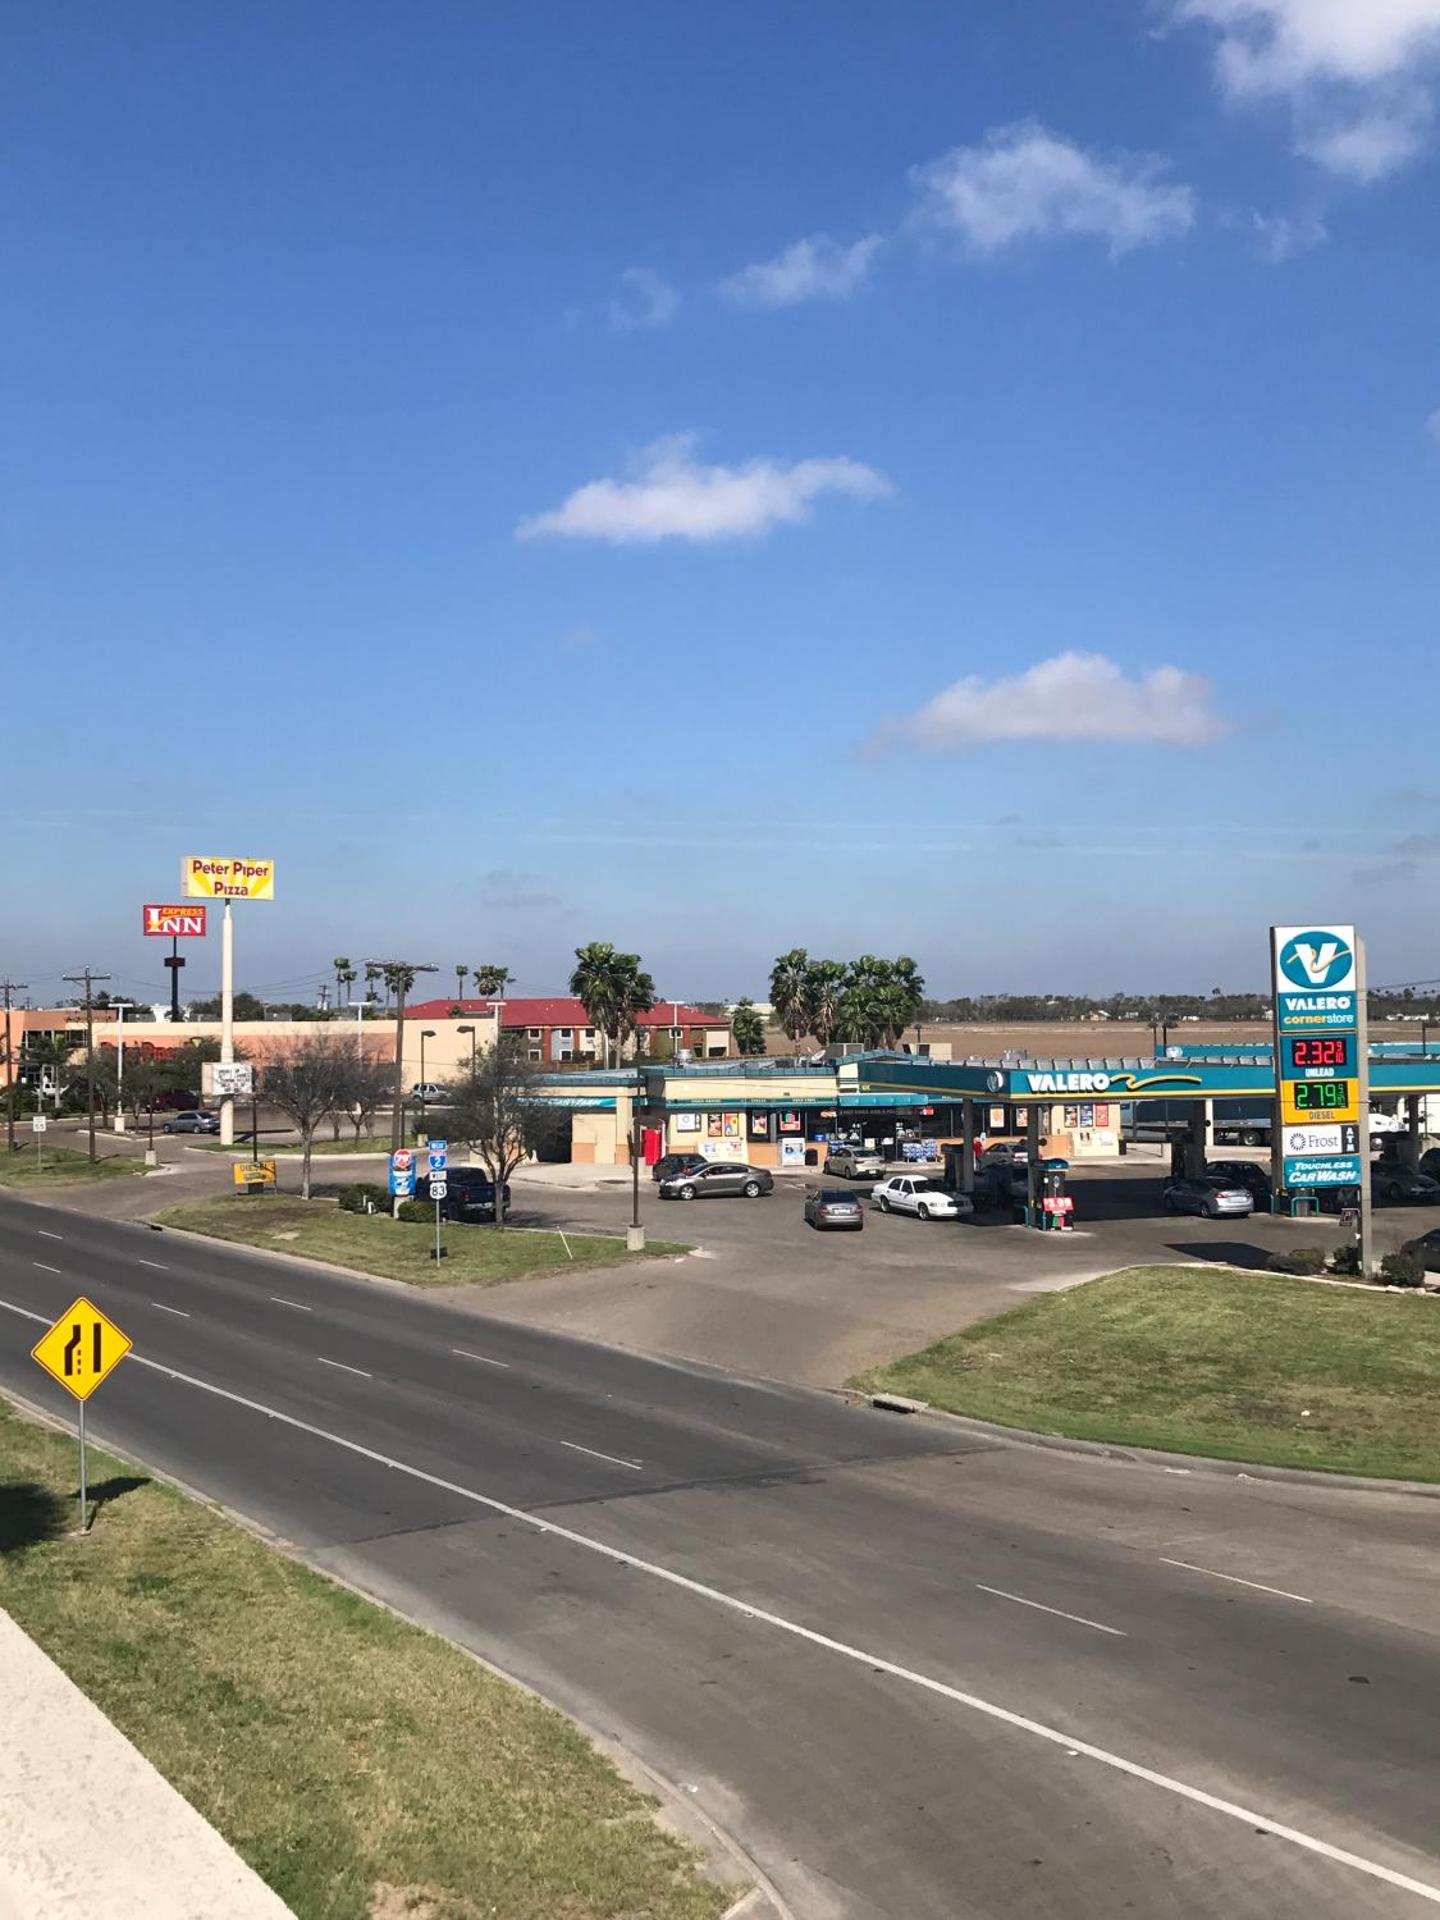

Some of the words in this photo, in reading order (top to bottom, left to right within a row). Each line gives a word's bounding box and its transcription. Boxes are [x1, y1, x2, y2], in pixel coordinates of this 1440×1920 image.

[193, 860, 229, 875] Peter
[233, 862, 269, 877] Piper
[214, 882, 248, 896] Pizza
[162, 907, 204, 916] EXPRESS
[147, 908, 203, 933] INN
[1285, 997, 1351, 1010] VALERO
[1284, 1013, 1354, 1025] cornerstore
[1028, 1073, 1110, 1092] VALERO
[1309, 1111, 1335, 1119] DIESEL
[1308, 1135, 1338, 1147] Frost
[1346, 1127, 1355, 1152] ATM
[434, 1157, 441, 1168] 2
[1295, 1162, 1352, 1170] TOUCHLESS
[1289, 1171, 1318, 1182] CAR
[1318, 1170, 1356, 1181] WASH
[432, 1185, 445, 1196] 83
